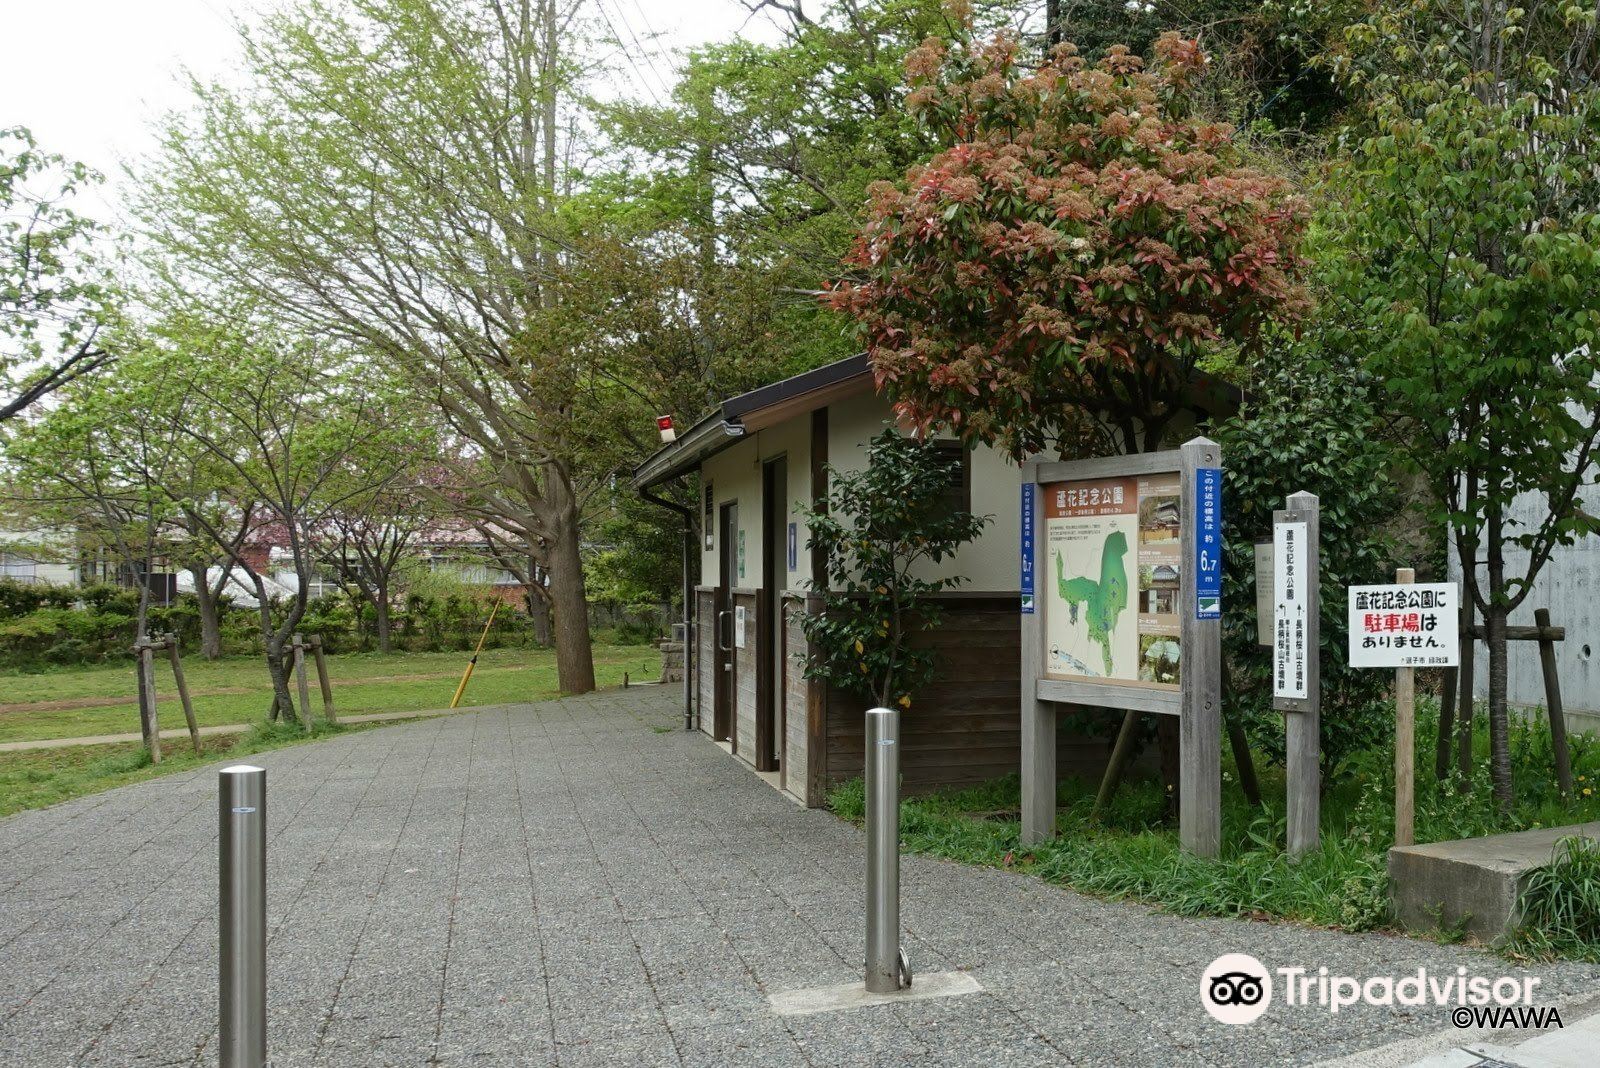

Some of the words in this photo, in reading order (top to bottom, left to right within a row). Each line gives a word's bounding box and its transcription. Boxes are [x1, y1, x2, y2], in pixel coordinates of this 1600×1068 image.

[1056, 486, 1124, 508] 蘆花記念公園
[1200, 549, 1217, 571] 6.7
[1286, 529, 1294, 600] 蘆花記念公園
[1356, 590, 1446, 610] 蘆花記念公園に
[1364, 613, 1438, 633] 駐車場は
[1362, 635, 1446, 648] ありません。
